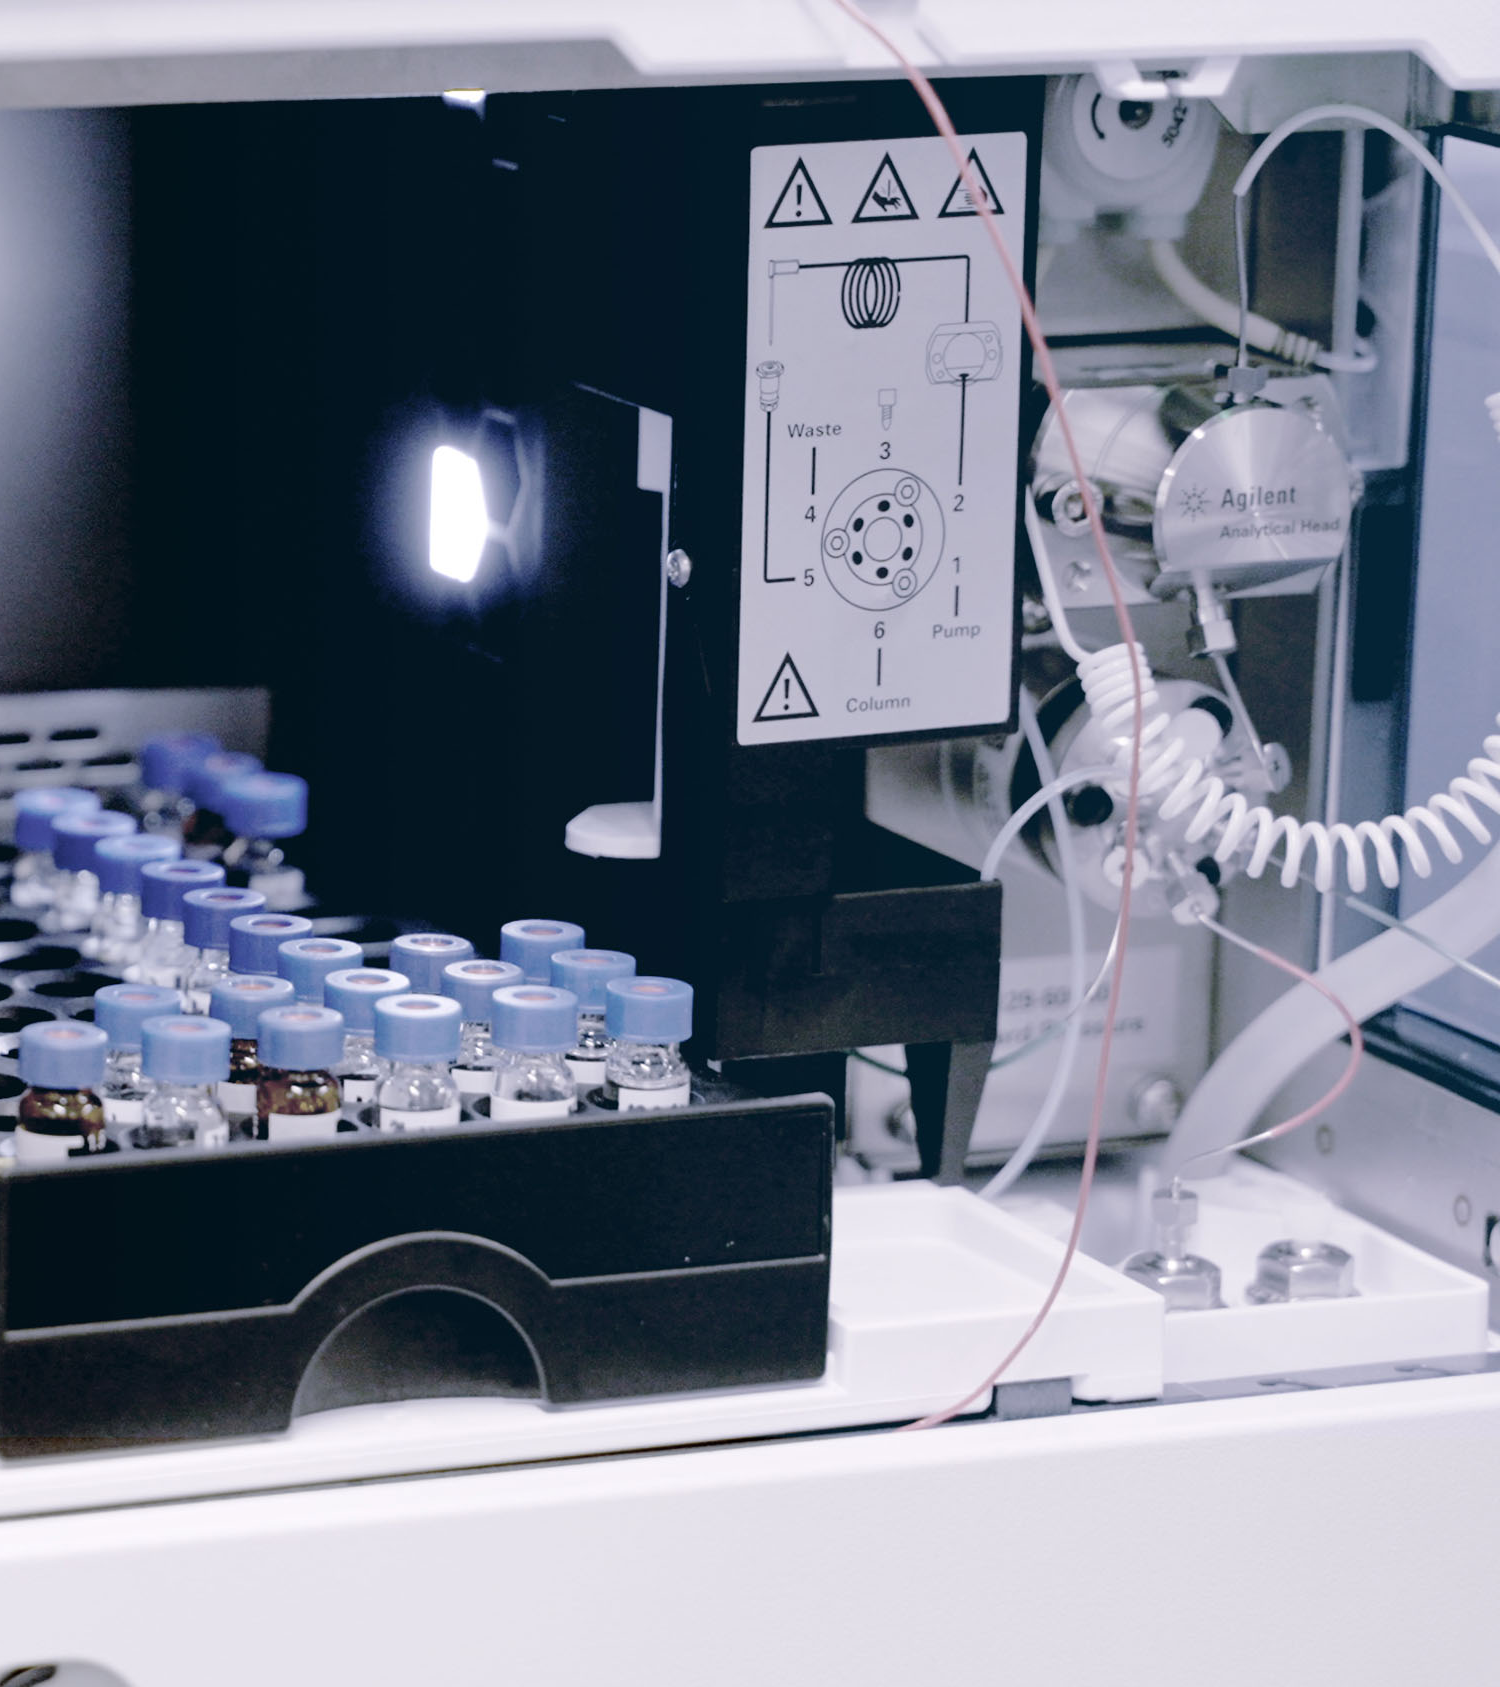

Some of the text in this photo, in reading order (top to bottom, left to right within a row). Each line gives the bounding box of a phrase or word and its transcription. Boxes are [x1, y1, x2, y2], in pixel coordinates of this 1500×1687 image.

[787, 421, 842, 439] Waste
[879, 442, 891, 460] 3
[952, 495, 964, 513] 2
[1220, 486, 1297, 512] Agilent
[804, 505, 817, 523] 4
[1219, 519, 1341, 539] Analytical Head
[952, 557, 961, 574] 1
[803, 569, 815, 588] 5
[874, 622, 886, 640] 6
[931, 621, 981, 641] Pump
[845, 694, 911, 714] Column
